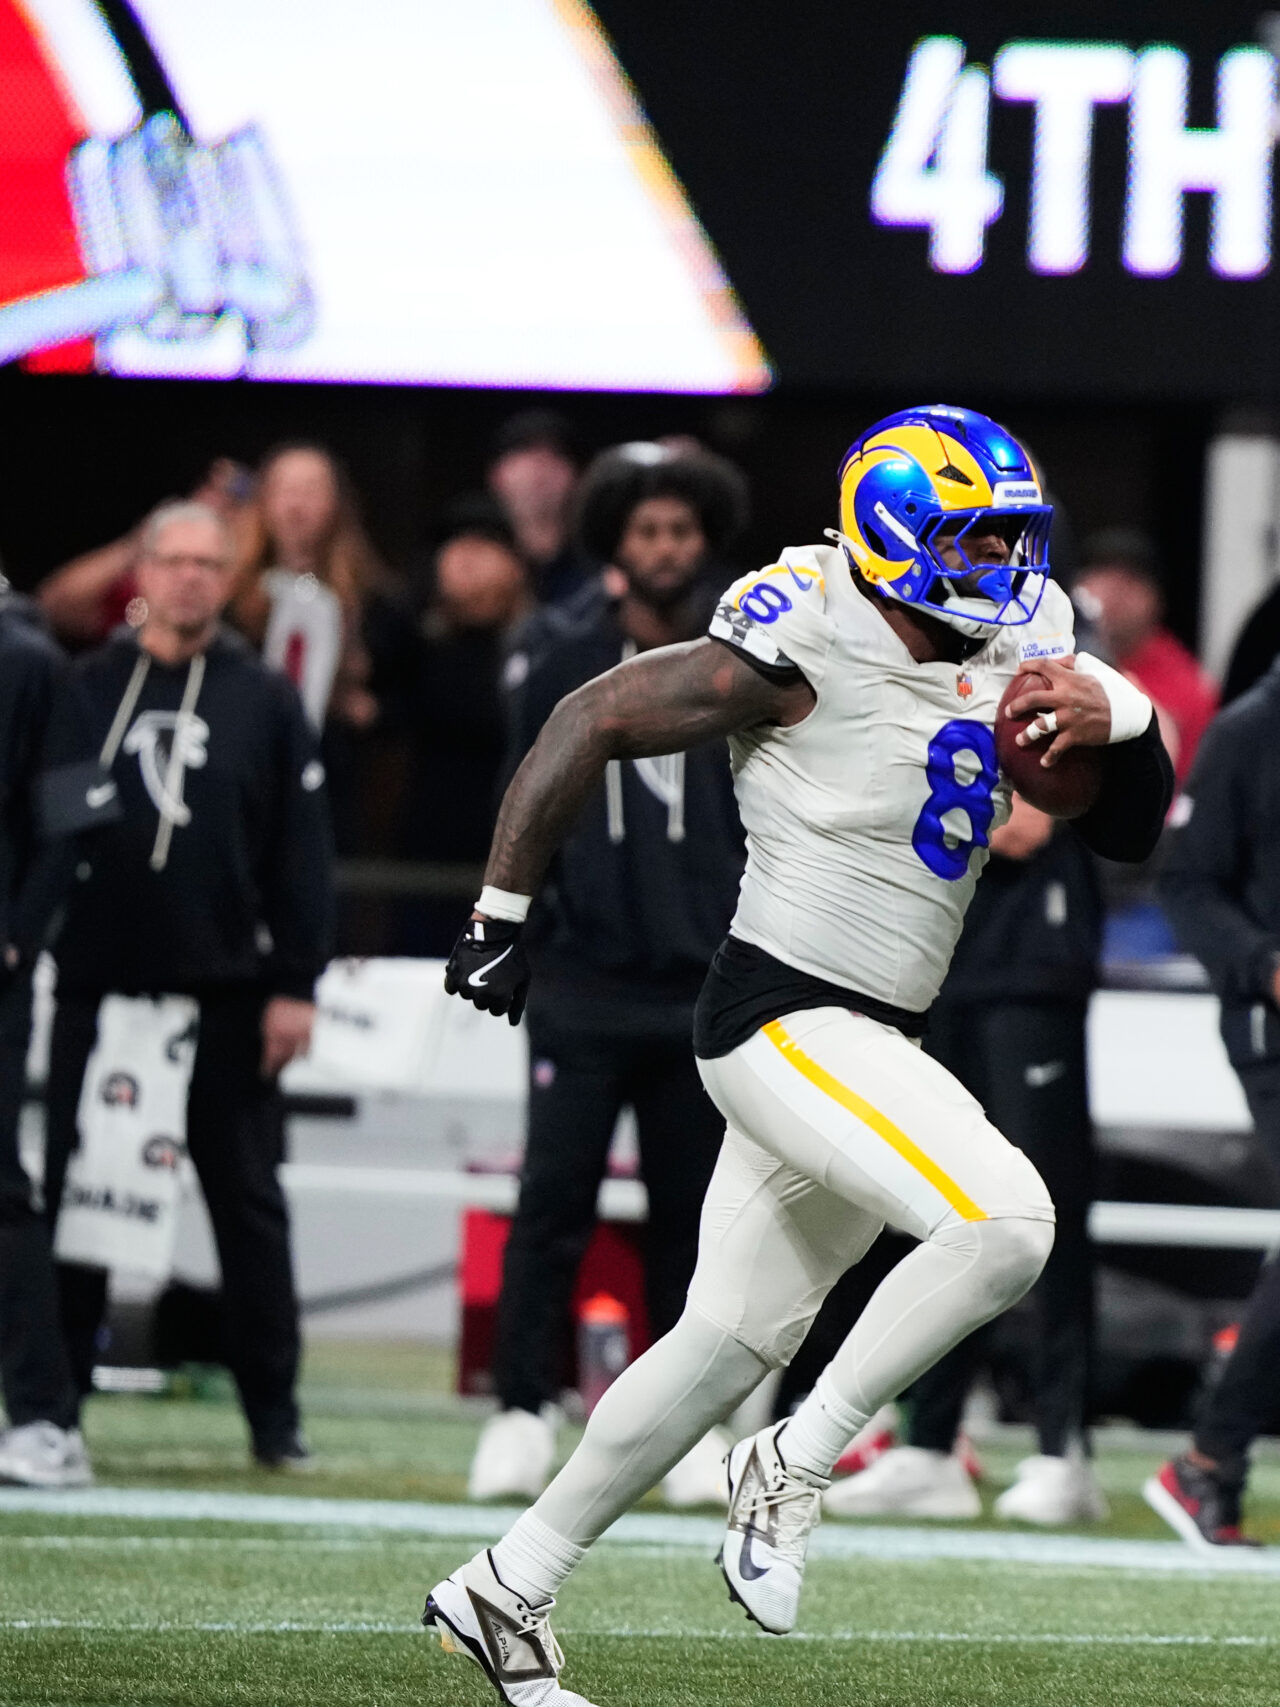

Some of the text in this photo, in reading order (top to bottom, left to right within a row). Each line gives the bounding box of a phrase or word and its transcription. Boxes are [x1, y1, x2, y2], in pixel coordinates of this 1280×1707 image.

[871, 34, 1278, 279] 4TH
[739, 583, 792, 624] 8
[1022, 643, 1038, 652] LOS
[1023, 646, 1064, 659] ANGELES
[911, 719, 999, 881] 8
[491, 1621, 510, 1666] ALPHA
